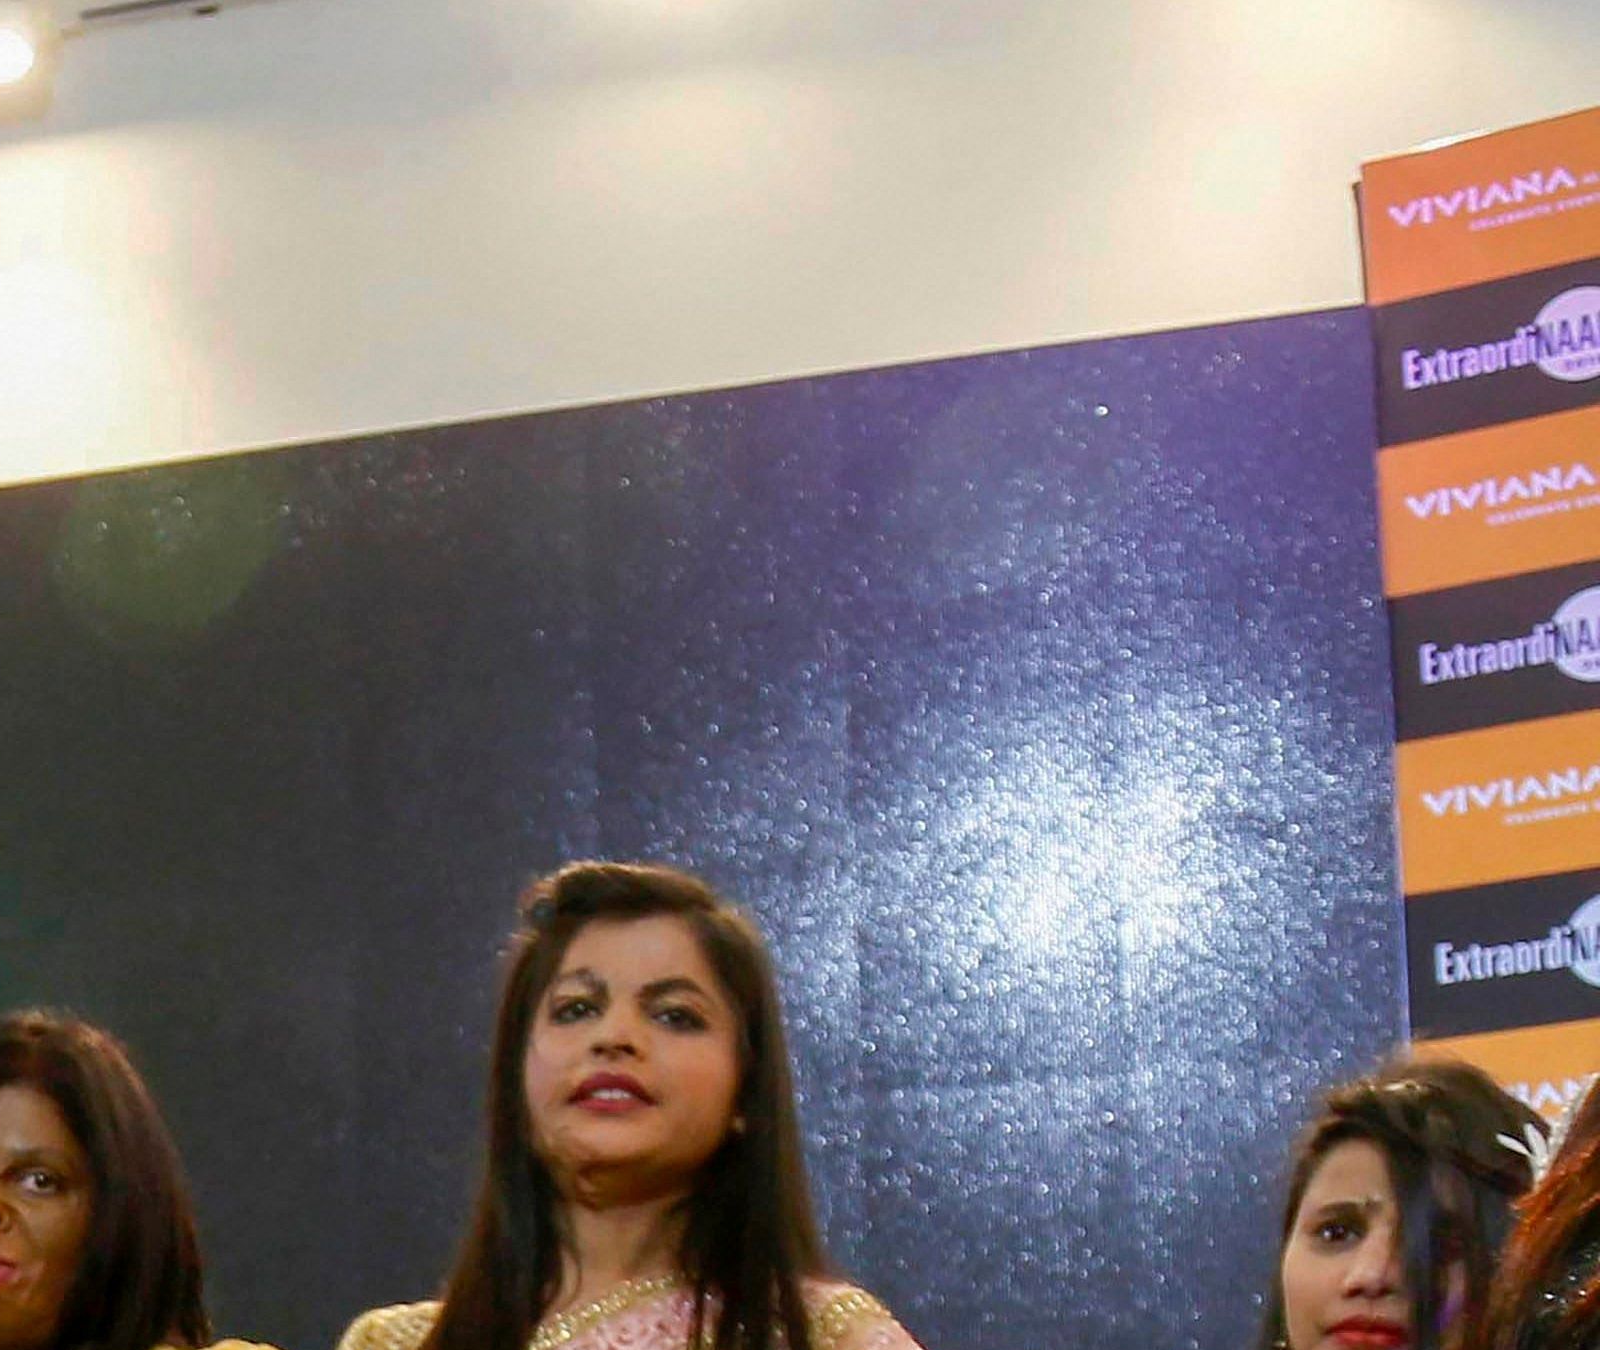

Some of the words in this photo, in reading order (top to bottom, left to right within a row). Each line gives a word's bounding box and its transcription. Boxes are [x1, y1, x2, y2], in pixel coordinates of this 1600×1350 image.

[1388, 166, 1578, 228] VIVIANA
[1402, 311, 1600, 390] ExtraordiNAA
[1405, 462, 1597, 519] VIVIANA
[1418, 617, 1600, 686] ExtraordiNA
